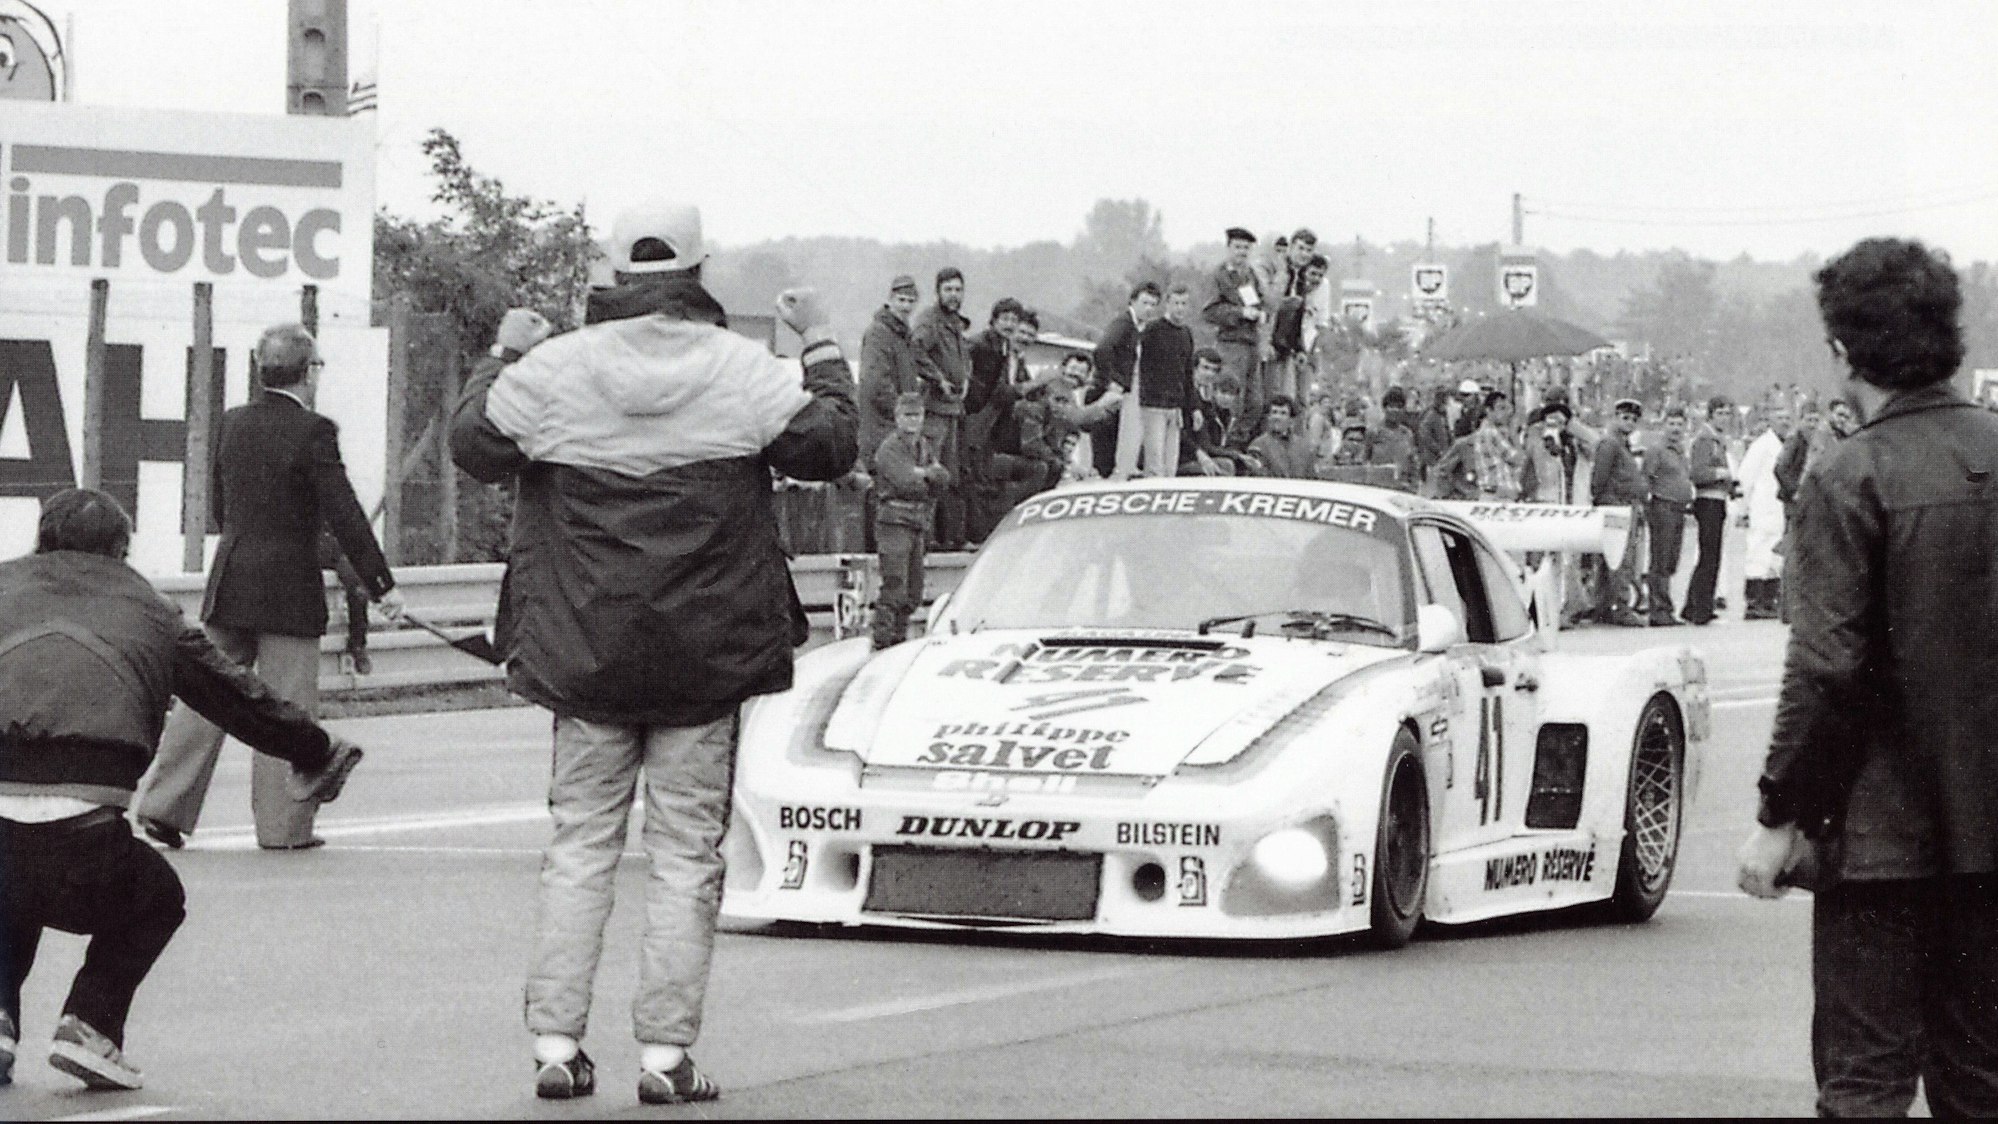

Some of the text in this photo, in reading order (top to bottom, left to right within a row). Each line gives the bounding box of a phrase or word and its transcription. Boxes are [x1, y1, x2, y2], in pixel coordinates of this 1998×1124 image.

[7, 176, 341, 280] infotec
[1017, 492, 1200, 525] PORSCHE
[1219, 494, 1378, 533] KREMER
[933, 722, 1131, 744] philippe
[917, 740, 1113, 770] salvet
[1474, 695, 1502, 826] 41
[780, 807, 862, 831] BOSCH
[896, 816, 1081, 841] DUNLOP
[1117, 822, 1220, 846] BILSTEIN
